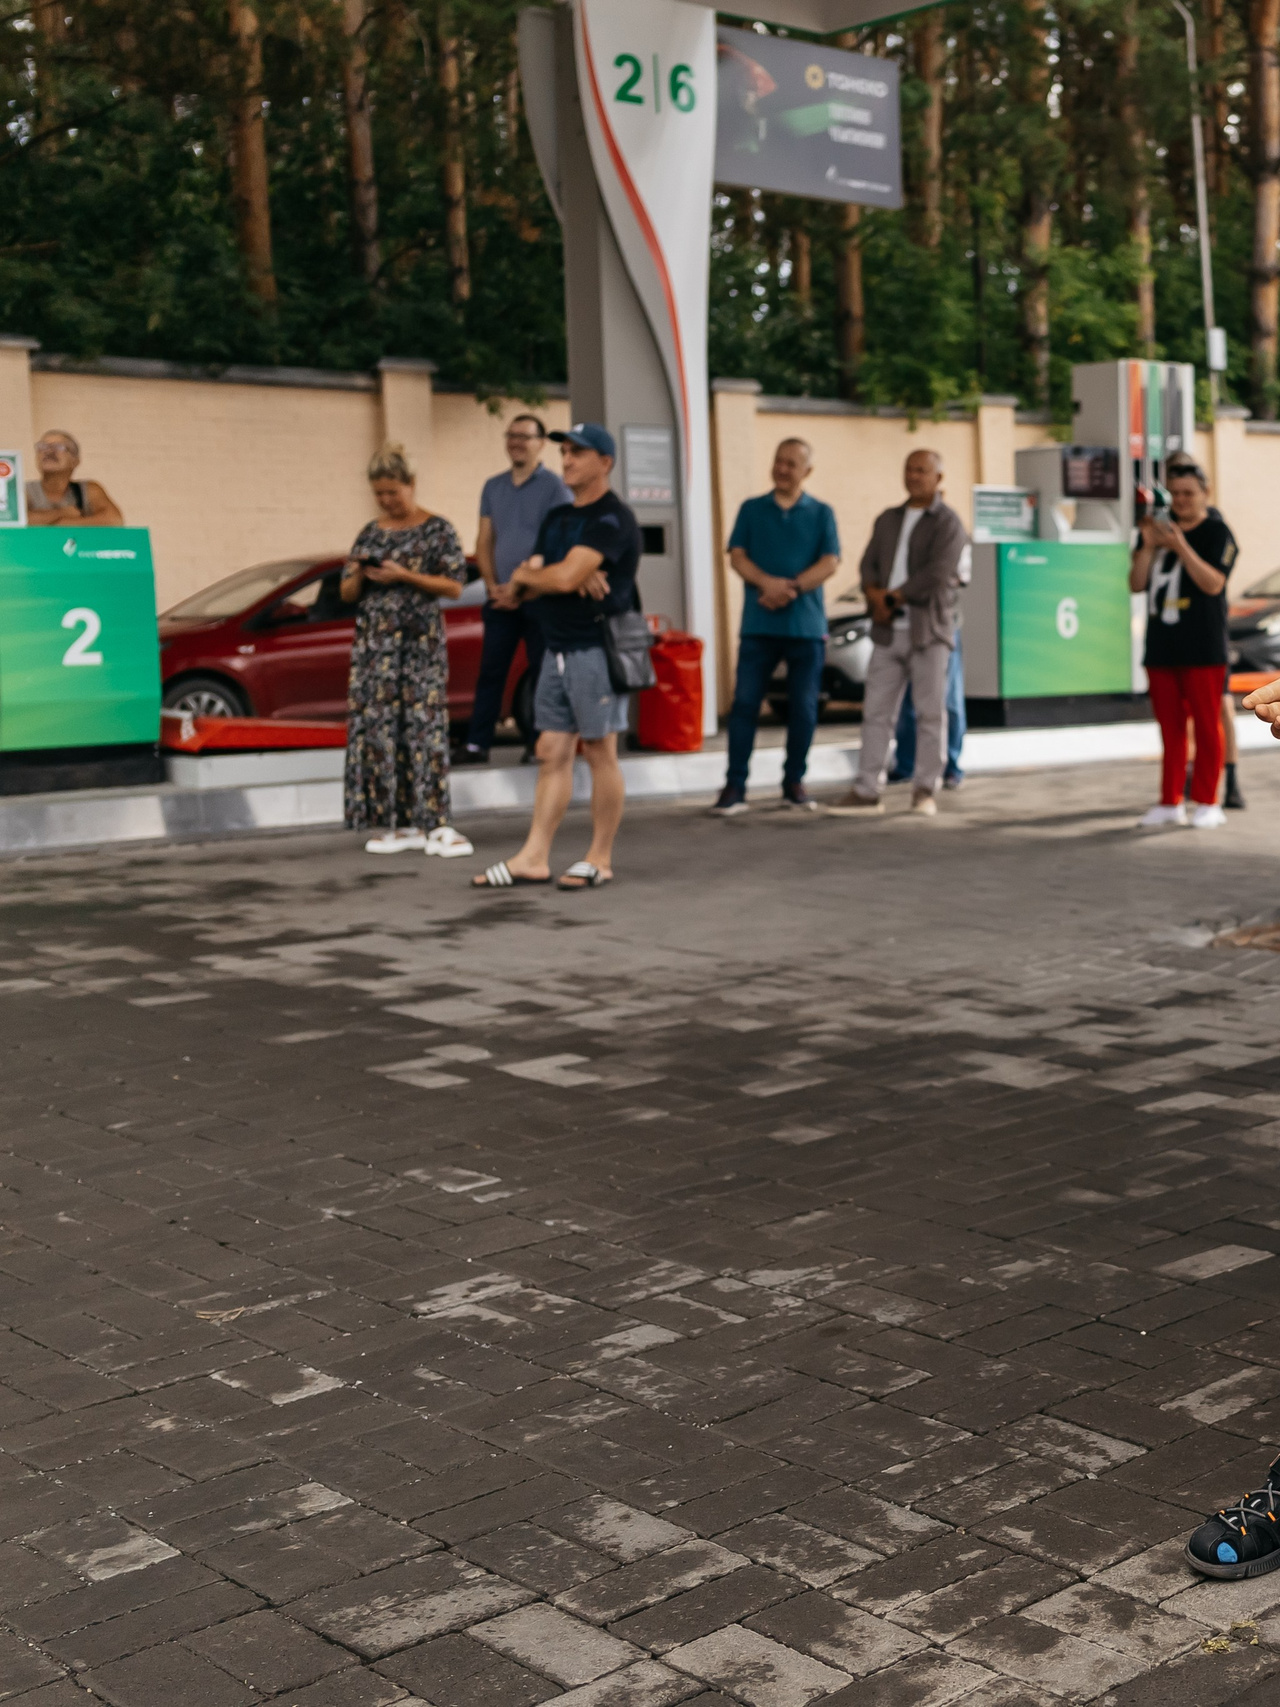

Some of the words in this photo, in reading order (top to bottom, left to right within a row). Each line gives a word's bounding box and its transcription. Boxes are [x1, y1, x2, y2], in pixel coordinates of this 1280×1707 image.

[614, 53, 643, 104] 2
[669, 64, 696, 112] 6
[61, 606, 103, 667] 2
[1056, 597, 1079, 639] 6
